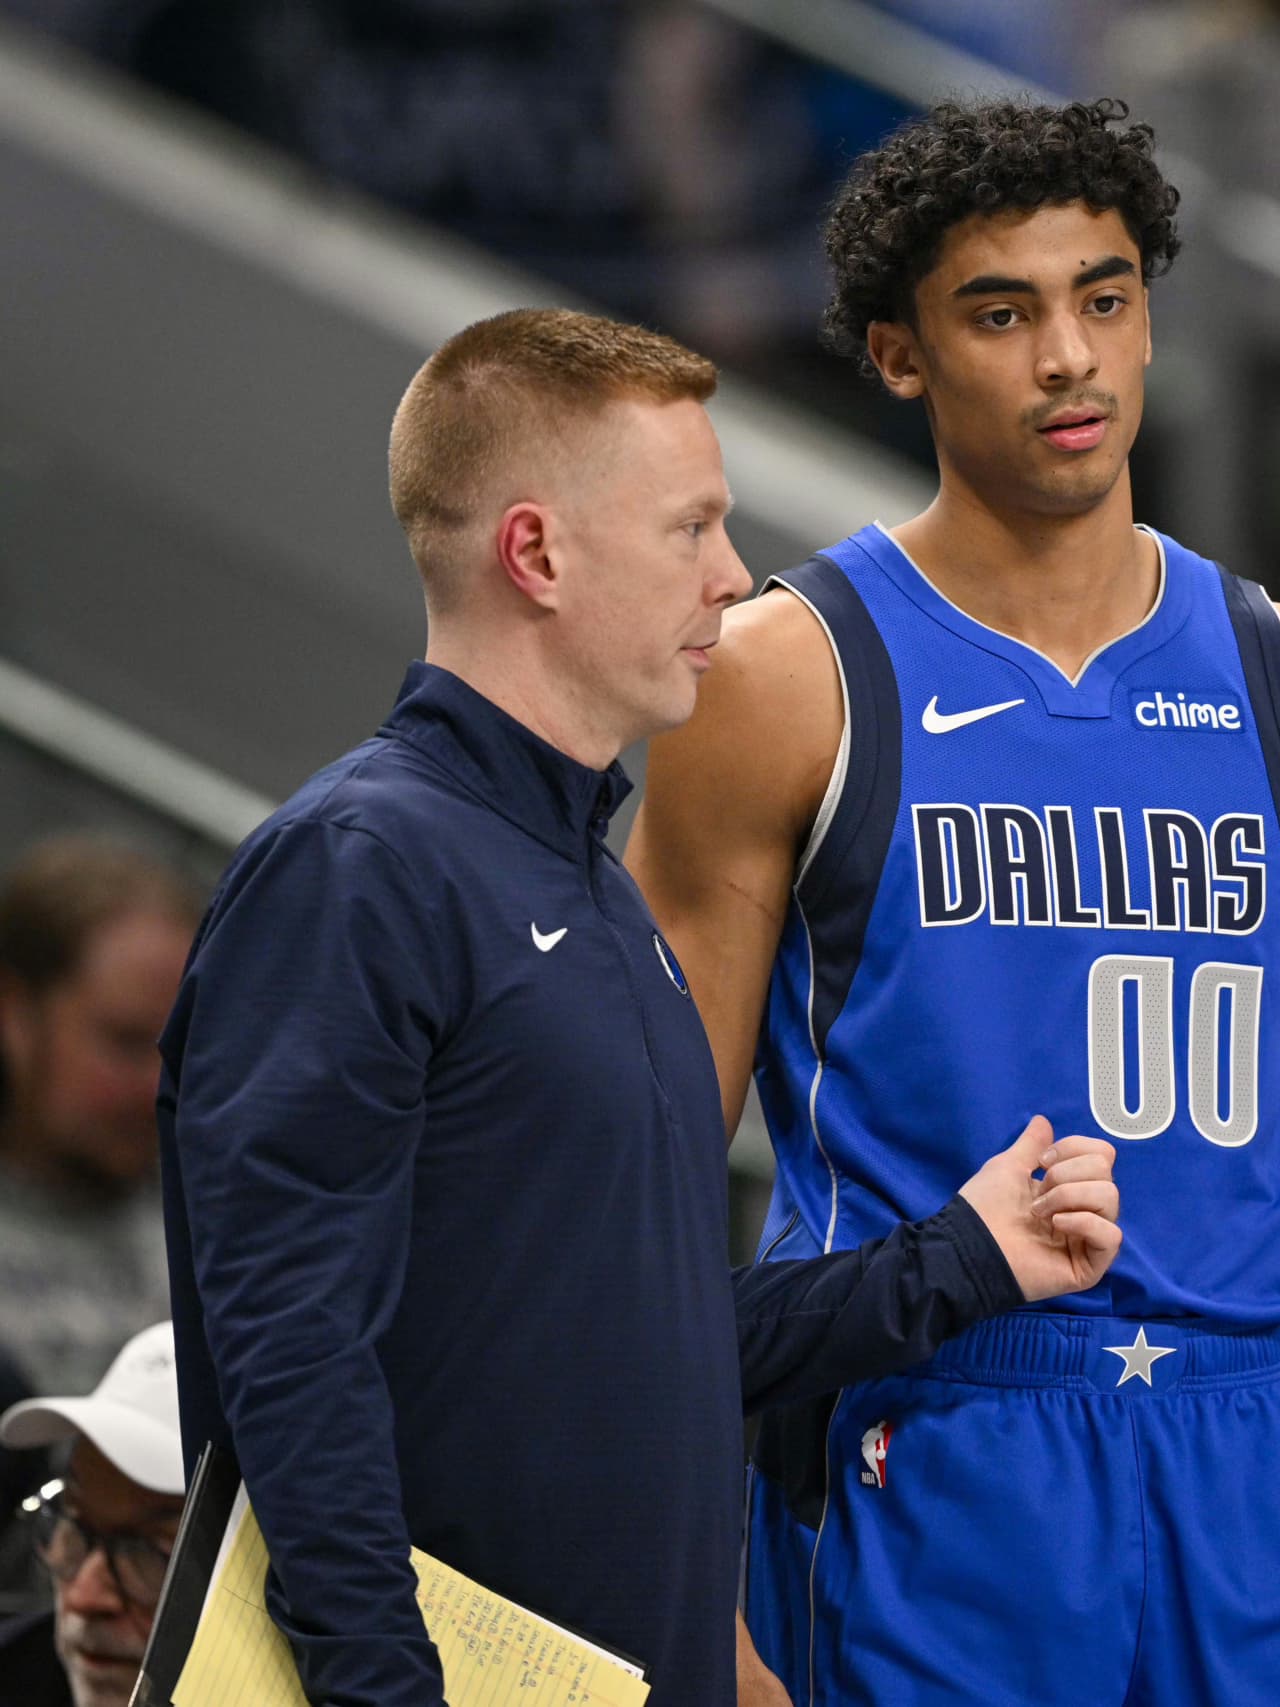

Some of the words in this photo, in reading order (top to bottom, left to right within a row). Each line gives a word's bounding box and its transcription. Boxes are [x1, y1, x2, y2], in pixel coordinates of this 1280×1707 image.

[1135, 692, 1241, 729] chime
[911, 803, 1266, 936] DALLAS
[1087, 954, 1264, 1148] 00
[861, 1472, 875, 1485] NBA
